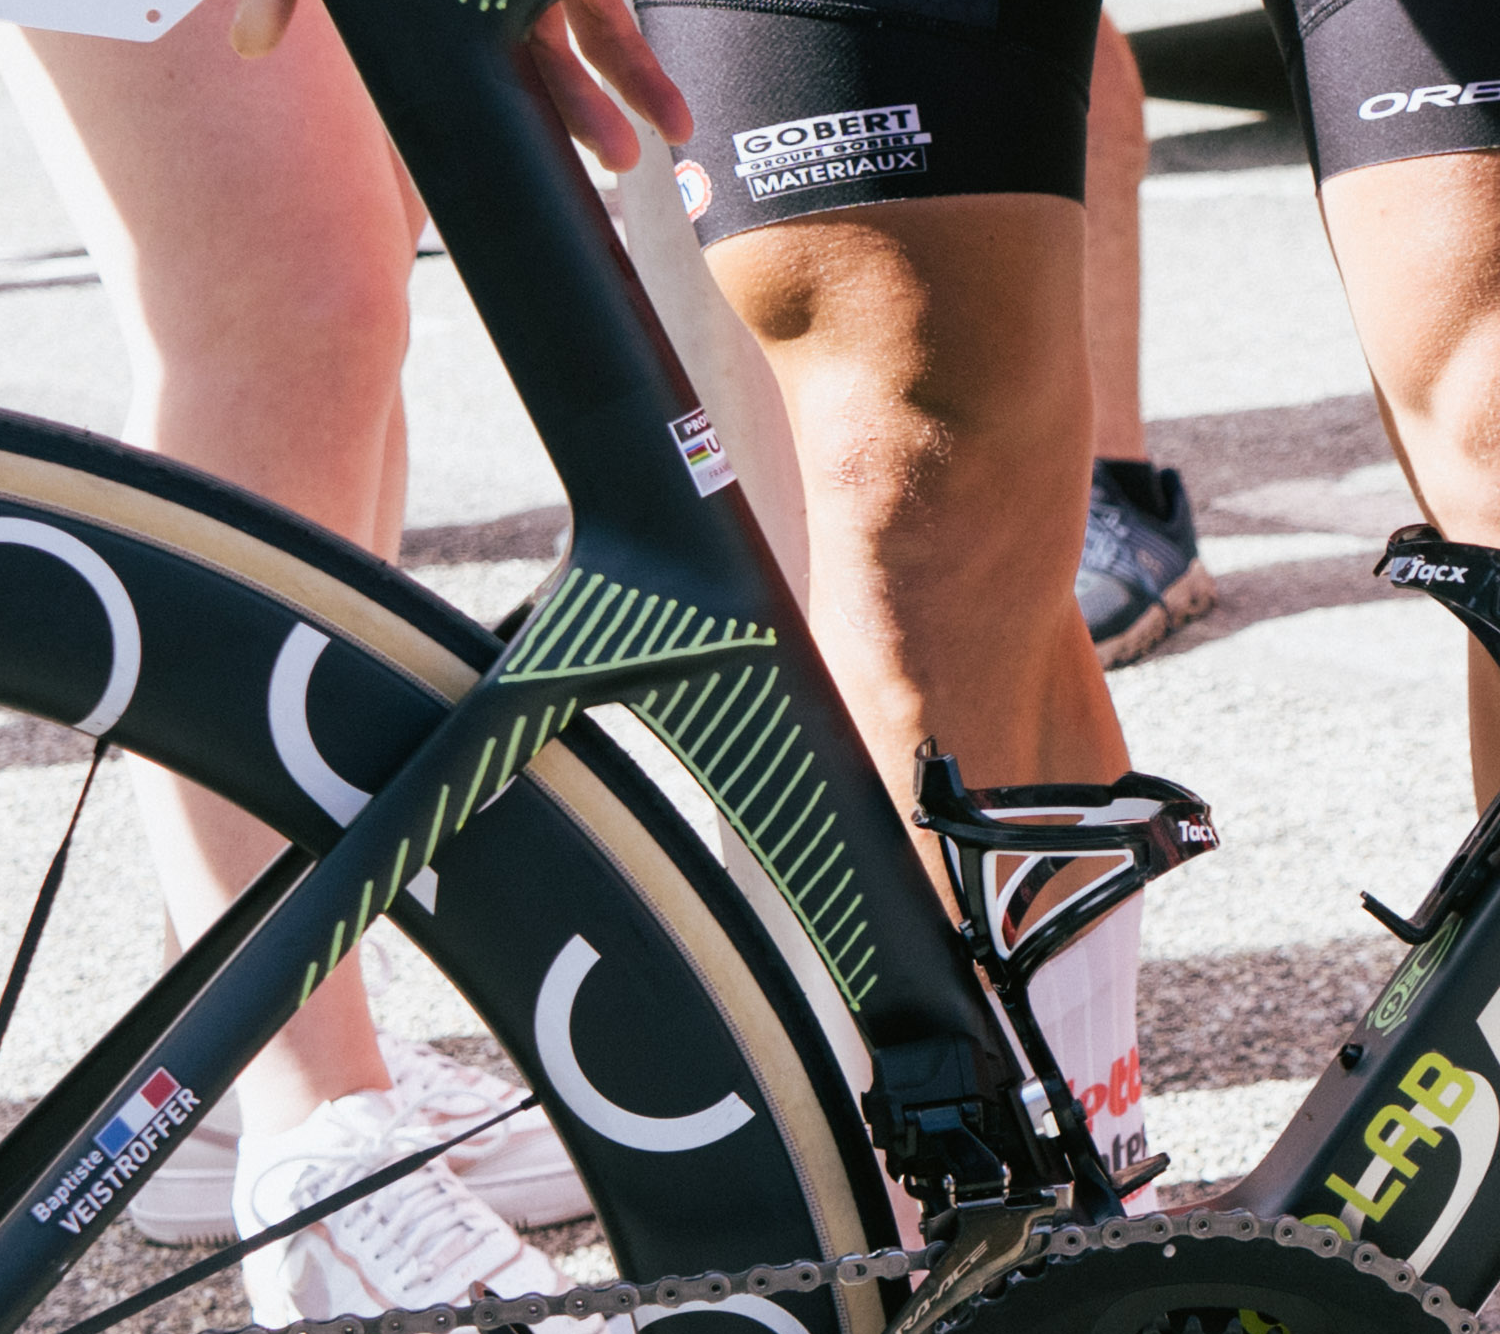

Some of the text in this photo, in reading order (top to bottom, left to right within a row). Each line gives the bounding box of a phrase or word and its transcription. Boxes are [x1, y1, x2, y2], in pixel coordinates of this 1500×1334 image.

[743, 109, 912, 154] GOBERT
[751, 151, 917, 197] MATERIAUX
[1178, 820, 1216, 843] Tacx
[58, 1088, 201, 1234] VEISTROFFER
[30, 1149, 104, 1223] Baptiste
